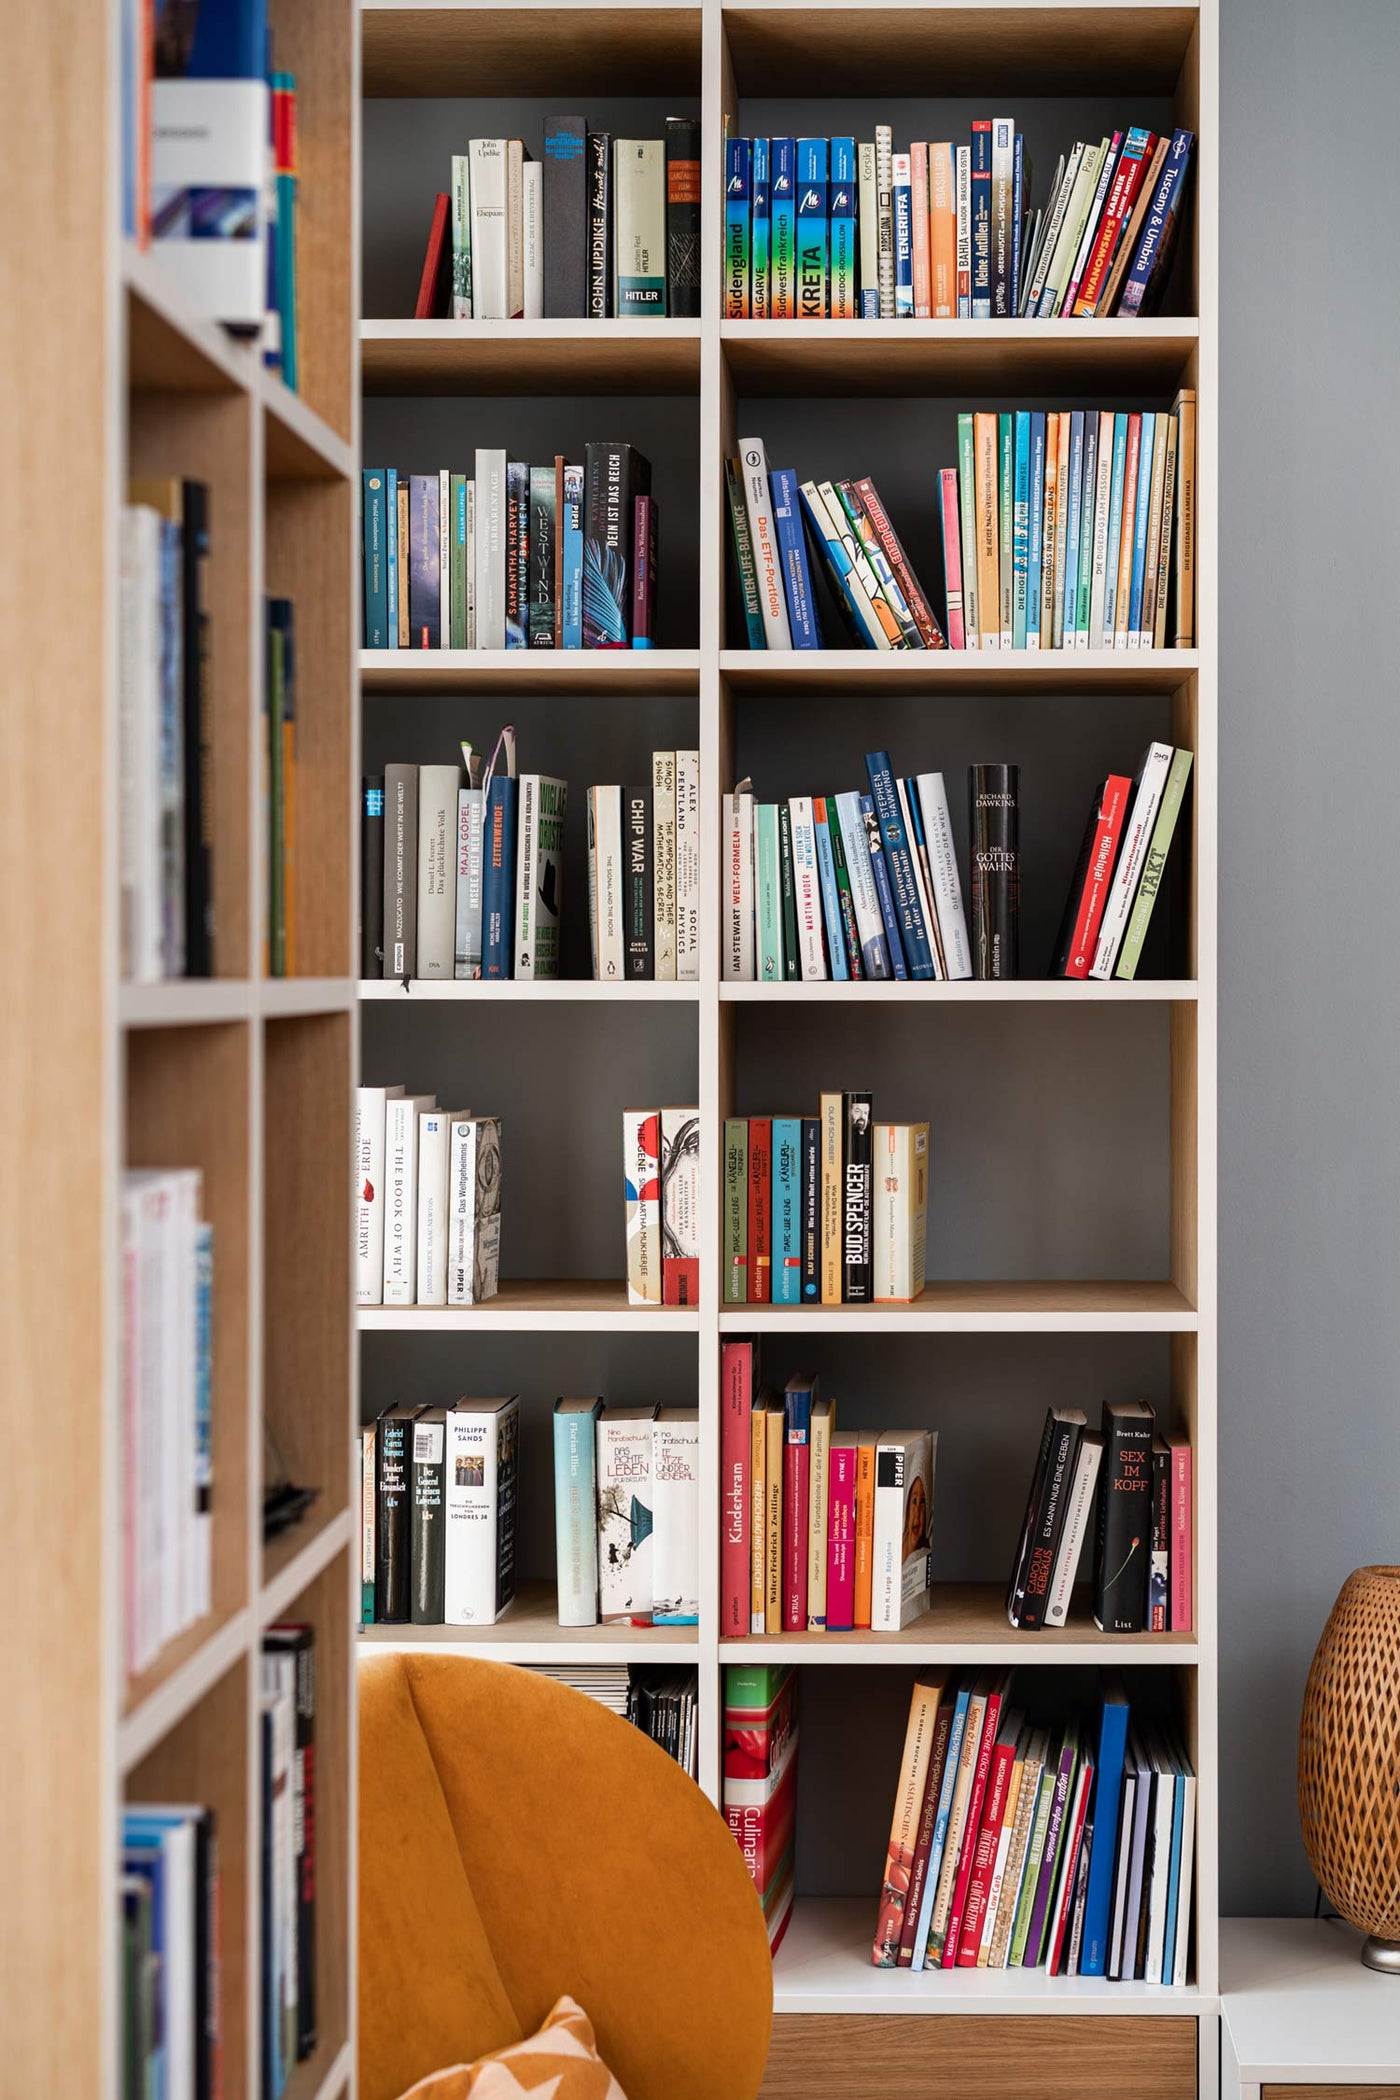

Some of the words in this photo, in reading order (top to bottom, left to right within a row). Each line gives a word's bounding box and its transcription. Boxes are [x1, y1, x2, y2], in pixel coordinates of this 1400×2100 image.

[863, 146, 872, 181] Korsika
[1082, 151, 1096, 173] Paris
[1096, 162, 1112, 201] BRESLAU
[1107, 175, 1126, 216] KARIBIK
[1116, 196, 1128, 218] KLEINE
[1124, 163, 1137, 194] ANTILLEN
[1150, 168, 1178, 214] Tuscany
[881, 217, 891, 251] BARCELONA
[898, 194, 909, 261] TENERIFFA
[1035, 232, 1056, 284] Französische
[1049, 176, 1072, 231] Atlantikküste
[1151, 217, 1161, 225] &
[593, 218, 604, 270] UPDIKE
[975, 222, 988, 257] Antillen
[1137, 227, 1158, 271] Umbria
[729, 224, 746, 319] Südengland
[777, 214, 787, 318] Südwestfrankreich
[975, 259, 988, 287] Kleine
[1084, 219, 1116, 299] IWANOWSKI'S
[593, 276, 604, 317] JOHN
[626, 291, 658, 300] HITLER
[755, 267, 764, 318] ALGARVE
[802, 246, 820, 317] KRETA
[1039, 288, 1056, 318] DUMONT
[609, 454, 620, 481] REICH
[1166, 450, 1175, 499] MOUNTAINS
[608, 486, 619, 503] DAS
[780, 475, 790, 506] ullstein
[509, 498, 517, 545] HARVEY
[571, 505, 579, 529] PIPER
[608, 507, 619, 521] IST
[758, 517, 768, 539] Das
[1163, 500, 1172, 526] ROCKY
[608, 525, 618, 546] DEIN
[1161, 545, 1169, 554] IN
[1162, 528, 1170, 544] DEN
[519, 502, 527, 610] UMLAUFBAHNEN
[734, 505, 758, 614] AKTIEN-LIFE-BALANCE
[509, 550, 517, 614] SAMANTHA
[761, 542, 779, 617] ETF-Portfolio
[1159, 555, 1169, 595] DIGEDAGS
[1158, 596, 1166, 609] DIE
[655, 760, 663, 787] SINGH
[665, 760, 673, 791] SIMON
[874, 773, 890, 819] STEPHEN
[882, 770, 898, 818] HAWKING
[459, 803, 469, 841] GÖPEL
[471, 803, 480, 834] DENKEN
[631, 799, 644, 835] CHIP
[937, 806, 948, 839] WELT
[470, 837, 479, 852] NEU
[493, 805, 503, 867] ZEITENWENDE
[943, 841, 951, 852] DER
[460, 844, 469, 875] MAJA
[470, 856, 479, 875] WELT
[632, 839, 644, 873] WAR
[656, 824, 664, 884] MATHEMATICAL
[976, 852, 1015, 862] GOTTES
[979, 862, 1013, 872] WAHN
[1093, 835, 1112, 881] Hölleluja!
[1122, 824, 1143, 884] Kinderhandball
[802, 874, 812, 898] MODER
[891, 851, 908, 907] Universum
[900, 849, 917, 907] Nußschale
[944, 853, 957, 894] FALTUNG
[1140, 848, 1166, 897] TAKT
[471, 877, 479, 908] UNSERE
[656, 887, 664, 922] SECRETS
[951, 898, 959, 910] DIE
[689, 909, 697, 952] SOCIAL
[733, 909, 741, 953] STEWART
[805, 902, 813, 930] MARTIN
[904, 913, 913, 930] Das
[913, 912, 922, 927] der
[1130, 901, 1149, 944] Handball
[916, 930, 925, 940] in
[395, 945, 403, 971] campus
[955, 940, 964, 972] ullstein
[637, 1123, 645, 1143] THE
[827, 1127, 835, 1165] SCHUBERT
[362, 1138, 371, 1171] ERDE
[395, 1146, 404, 1174] THE
[459, 1143, 469, 1197] Weltgeheimnis
[637, 1144, 646, 1172] GENE
[781, 1140, 791, 1182] KÄNGURU-
[394, 1179, 403, 1217] BOOK
[458, 1199, 466, 1213] Das
[846, 1164, 864, 1231] SPENCER
[360, 1207, 369, 1258] AMRITH
[394, 1224, 402, 1241] OF
[393, 1245, 402, 1277] WHY
[846, 1234, 864, 1264] BUD
[782, 1268, 790, 1299] ullstein
[614, 1447, 630, 1456] DAS
[614, 1455, 643, 1464] ACHTE
[1058, 1434, 1070, 1462] GEBEN
[1120, 1451, 1146, 1463] SEX
[383, 1463, 404, 1473] Hundert
[418, 1476, 439, 1485] General
[423, 1468, 433, 1476] Der
[607, 1463, 649, 1477] LEBEN
[656, 1472, 695, 1480] GENERAL
[895, 1455, 904, 1486] PIPER
[1054, 1463, 1064, 1482] EINE
[1123, 1465, 1140, 1476] IM
[1050, 1484, 1061, 1501] NUR
[1114, 1479, 1148, 1491] KOPF
[416, 1496, 441, 1506] Labyrinth
[728, 1462, 743, 1543] Kinderkram
[771, 1483, 779, 1526] Zwillinge
[1045, 1502, 1057, 1526] KANN
[1043, 1527, 1051, 1537] ES
[770, 1531, 779, 1573] Friedrich
[1027, 1547, 1043, 1594] CAROLIN
[1036, 1549, 1053, 1595] KEBEKUS
[770, 1573, 778, 1604] Walter
[791, 1594, 799, 1614] TRIAS
[1115, 1620, 1132, 1629] List
[982, 1707, 997, 1753] SPANISCHE
[926, 1719, 948, 1802] Ayurveda-Kochbuch
[977, 1755, 990, 1780] KÜCHE
[995, 1757, 1008, 1785] ANASTASIA
[1038, 1790, 1051, 1815] WORLD
[1055, 1773, 1068, 1803] vegan
[922, 1803, 936, 1828] große
[989, 1786, 1003, 1822] ZAMPOUNIDIS
[1050, 1806, 1063, 1832] einfach
[920, 1829, 930, 1846] Das
[1035, 1817, 1047, 1832] THE
[930, 1844, 941, 1874] Christine
[936, 1818, 945, 1843] Lehner
[977, 1827, 996, 1869] ZUCKERFREI
[1031, 1832, 1044, 1850] FEED
[1044, 1831, 1060, 1863] genießen
[915, 1859, 925, 1880] Sabnis
[1029, 1851, 1039, 1865] WE
[911, 1881, 922, 1906] Sitaram
[991, 1874, 1002, 1894] Carb
[907, 1907, 917, 1926] Nicky
[963, 1879, 984, 1933] GLÜCKSREZEPTE
[989, 1895, 999, 1911] Low
